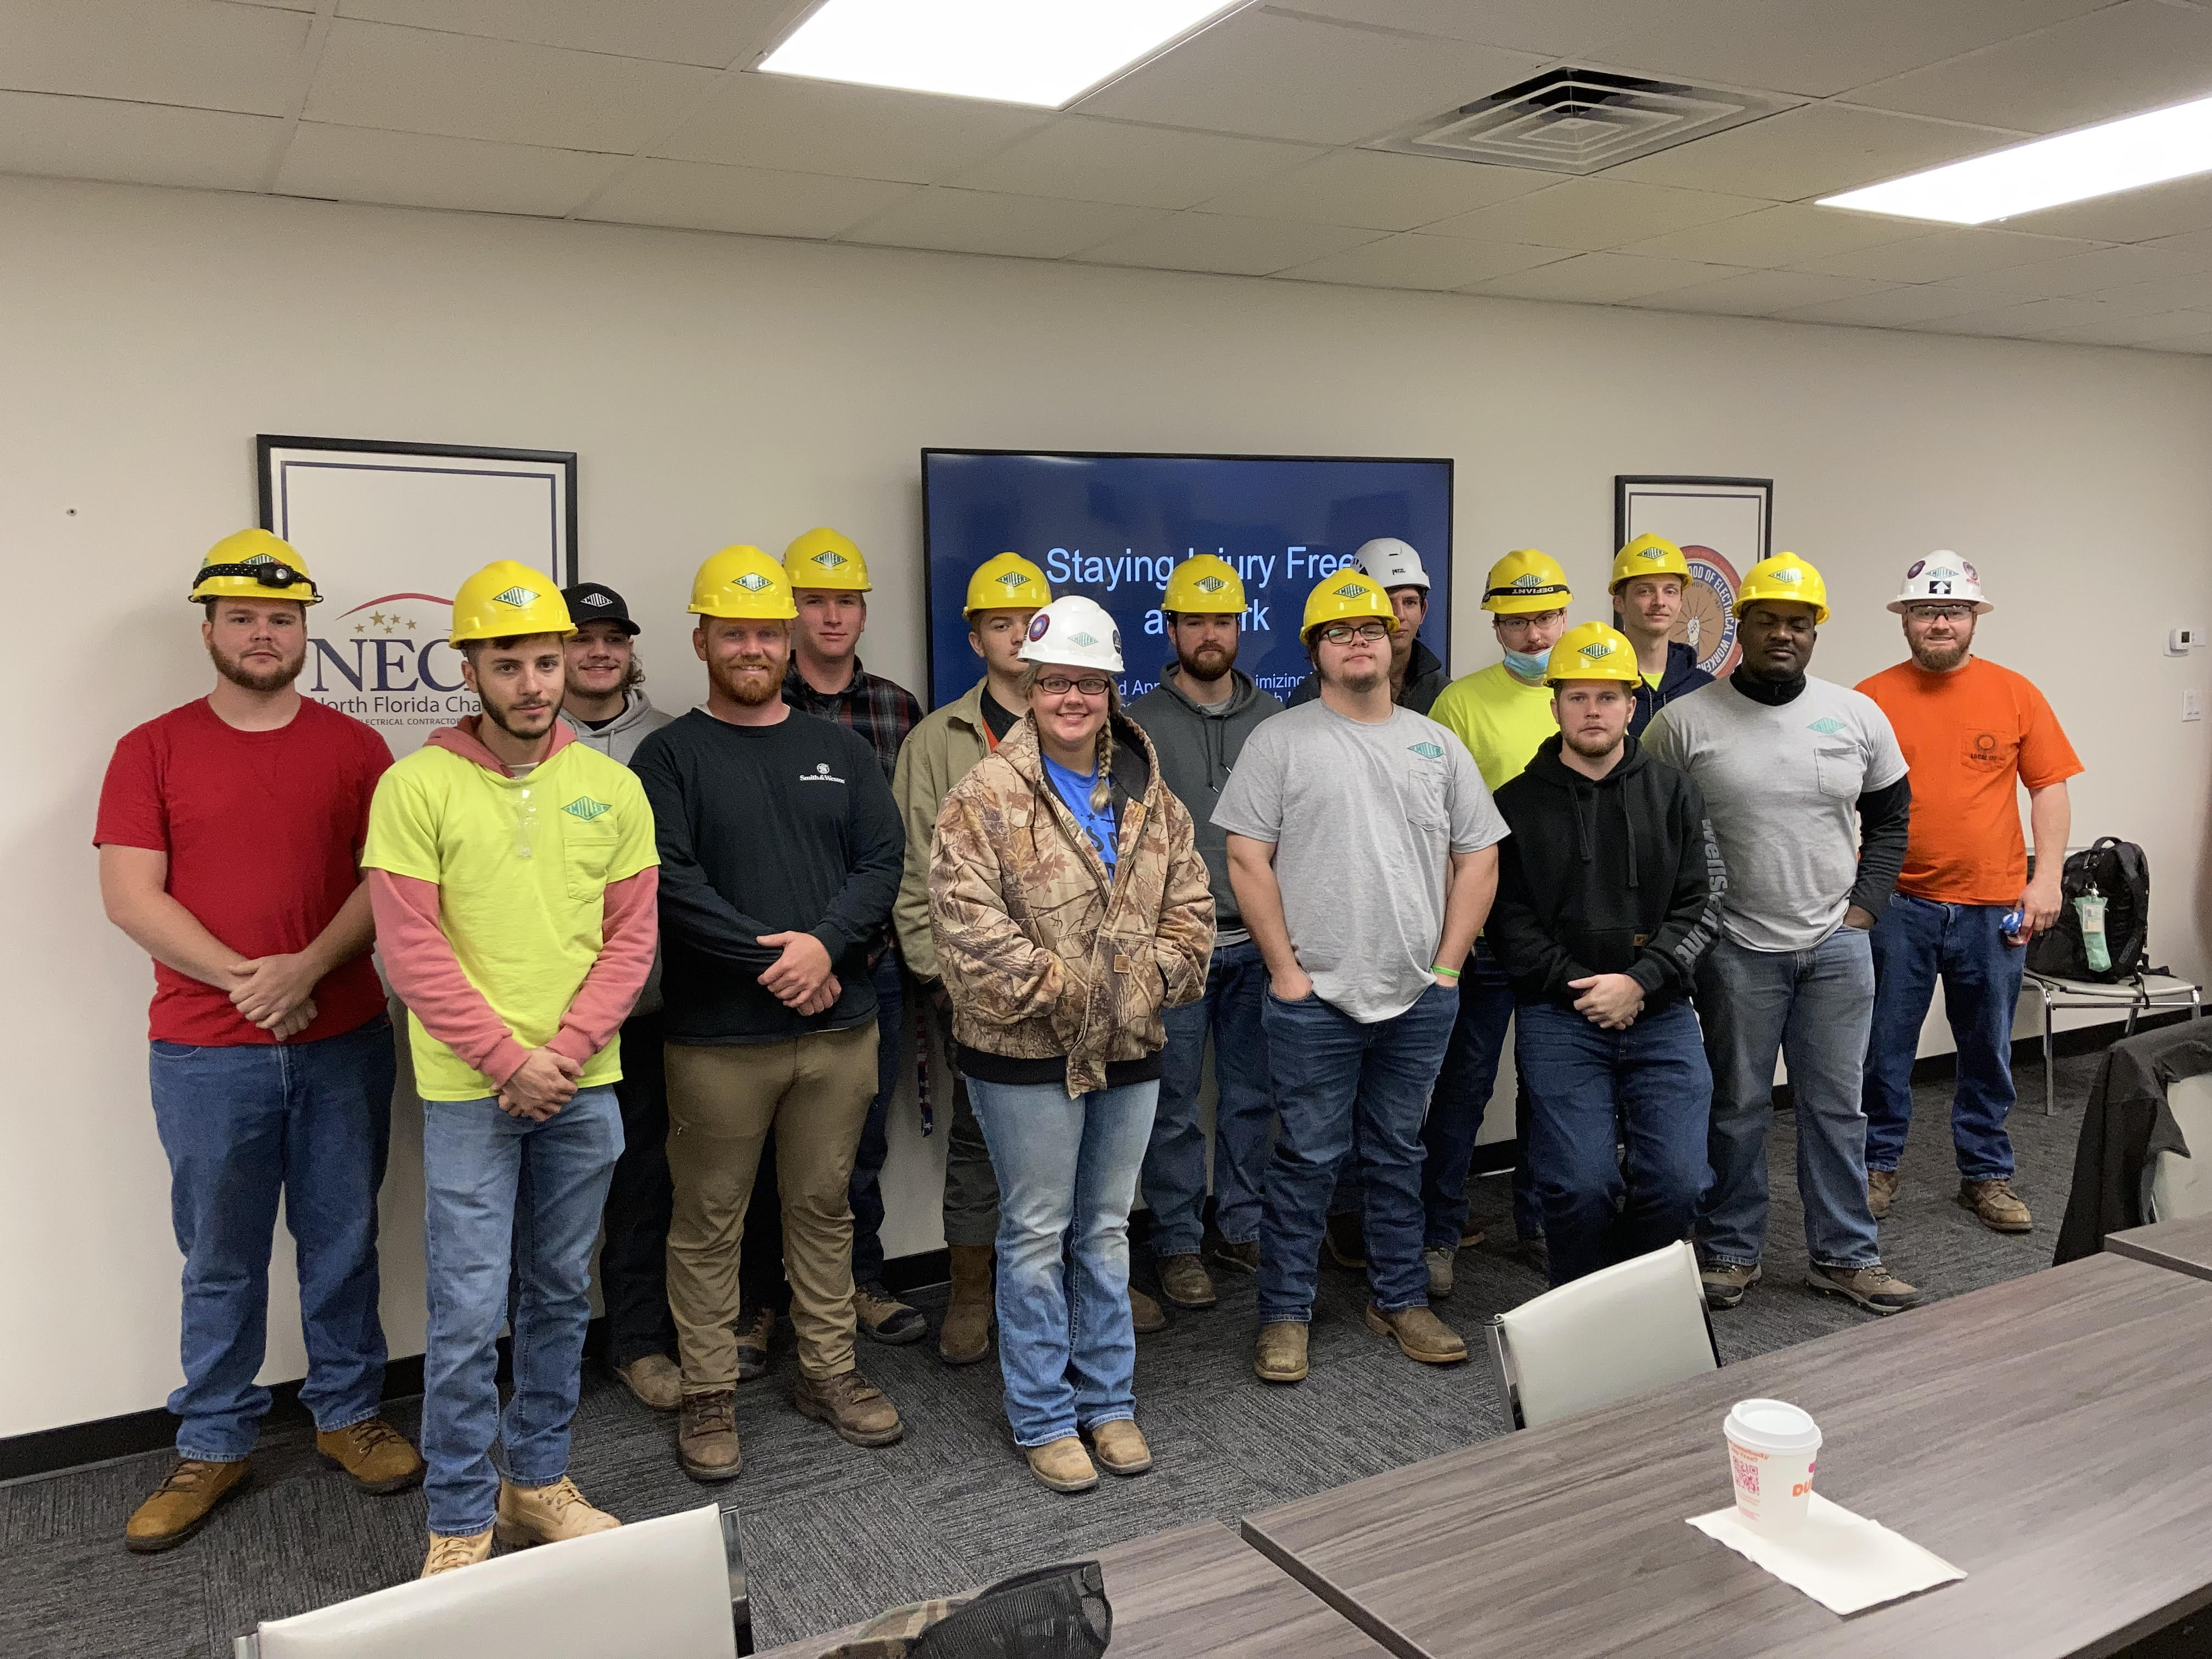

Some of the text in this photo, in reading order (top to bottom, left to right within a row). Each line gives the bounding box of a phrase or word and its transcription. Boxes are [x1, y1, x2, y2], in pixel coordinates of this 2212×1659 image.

[1046, 547, 1175, 592] Staying
[1705, 569, 1716, 583] OF
[1511, 586, 1554, 595] DEFIANT
[585, 594, 611, 606] MILLER
[307, 638, 467, 692] NEC
[321, 696, 368, 713] orth
[374, 696, 439, 713] Florida
